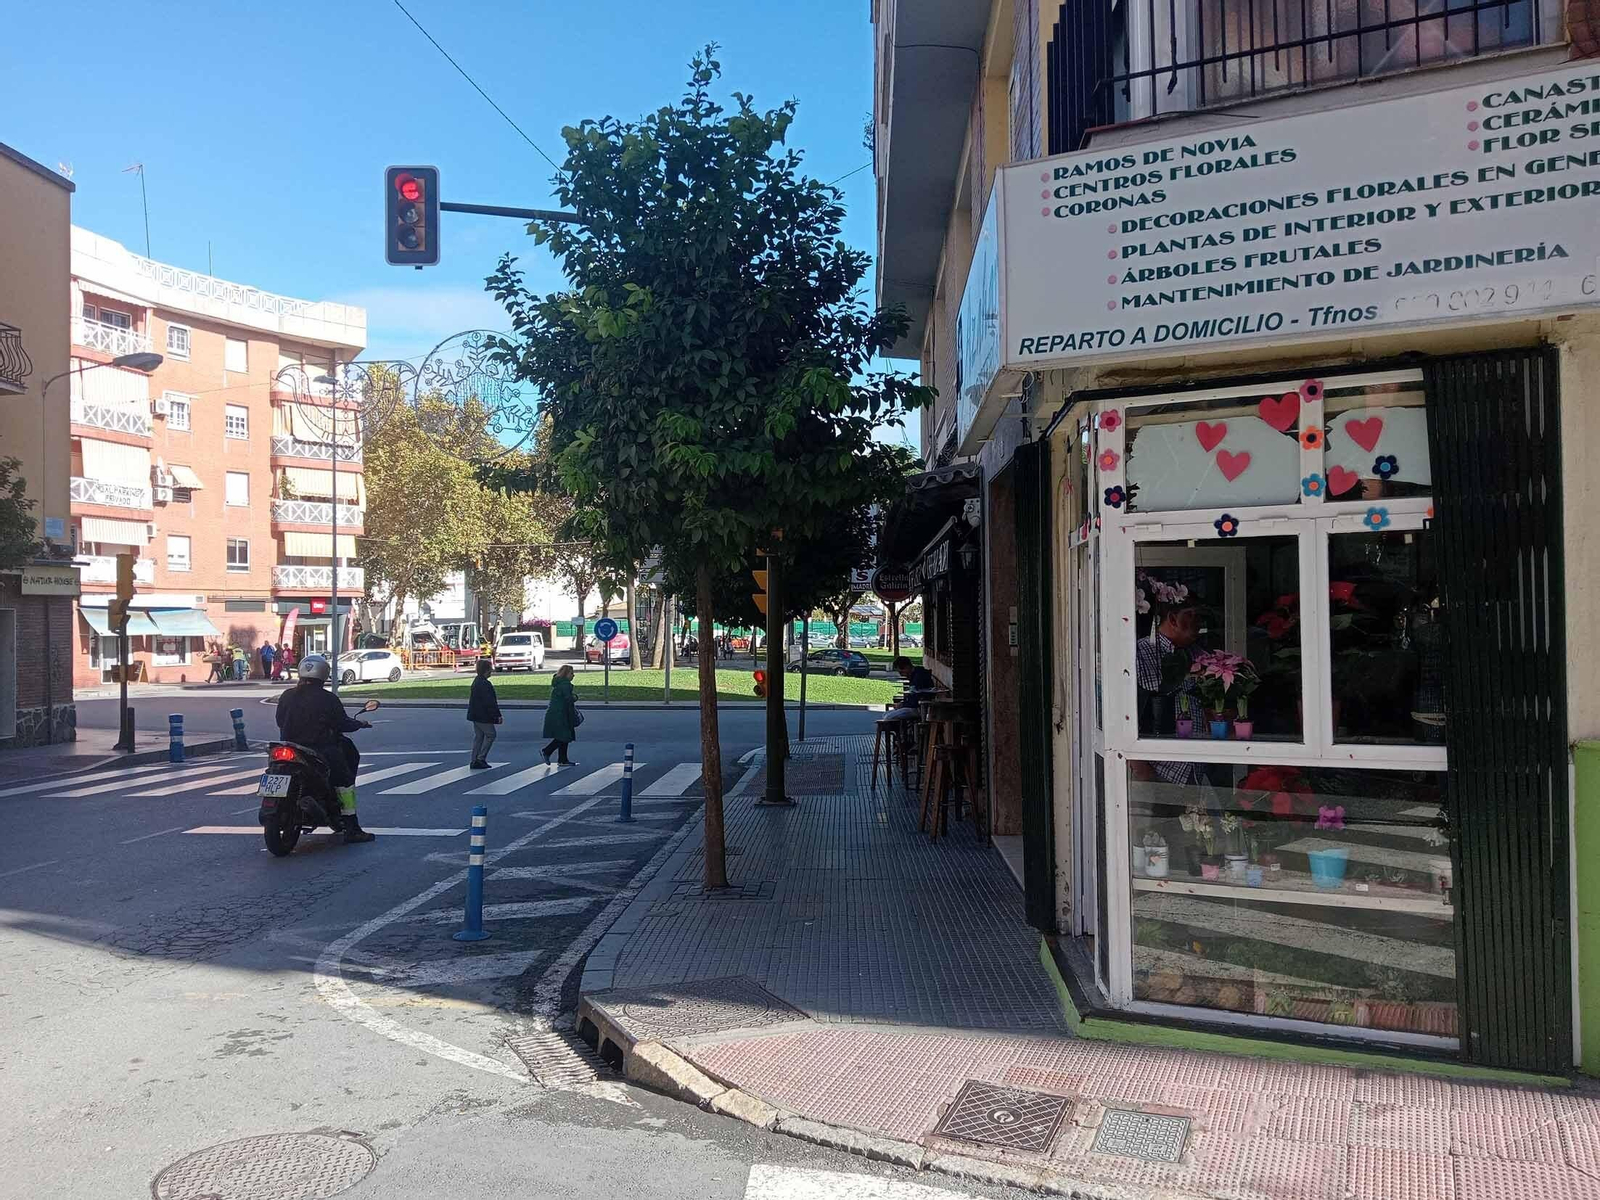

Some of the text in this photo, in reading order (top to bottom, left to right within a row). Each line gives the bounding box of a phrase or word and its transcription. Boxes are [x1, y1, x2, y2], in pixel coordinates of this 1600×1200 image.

[1054, 135, 1257, 180] RAMOS DE NOVIA
[1484, 129, 1560, 153] FLOR
[1054, 149, 1296, 199] CENTROS FLORALES
[1122, 193, 1318, 233] DECORACIONES
[1327, 171, 1469, 203] FLORALES
[1478, 163, 1515, 182] EN
[1054, 190, 1166, 218] CORONAS
[1122, 181, 1600, 259] PLANTAS DE INTERIOR Y EXTERIOR
[1121, 238, 1381, 284] ÁRBOLES FRUTALES
[1121, 242, 1569, 309] MANTENIMIENTO DE JARDINERÍA
[1019, 329, 1125, 355] REPARTO
[1130, 327, 1146, 345] A
[1154, 312, 1283, 342] DOMICILIO
[1309, 306, 1378, 327] Tfnos
